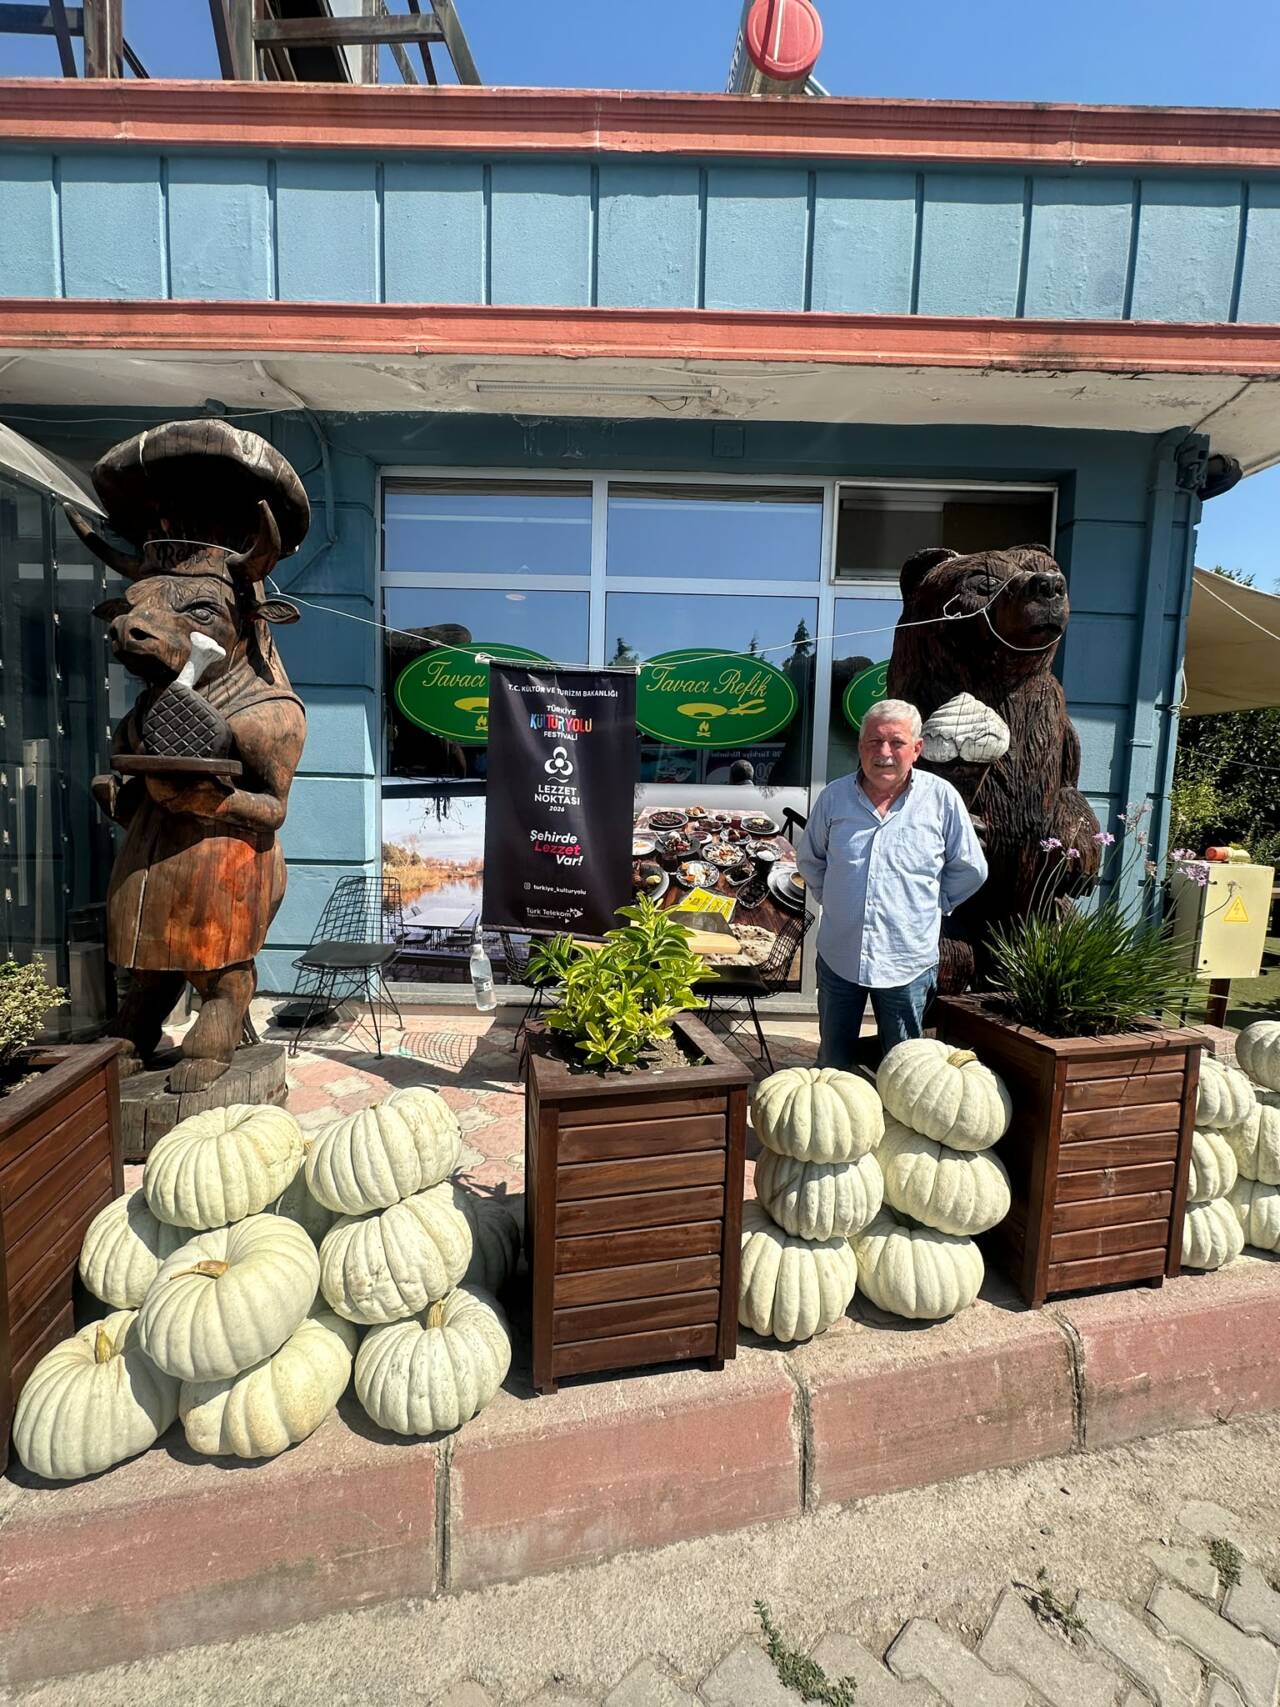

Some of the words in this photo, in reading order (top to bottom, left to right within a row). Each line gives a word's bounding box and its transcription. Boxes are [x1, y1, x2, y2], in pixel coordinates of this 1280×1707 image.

[422, 661, 487, 688] Tavacı
[508, 683, 521, 692] T.C.
[546, 686, 556, 694] VE
[556, 687, 582, 697] TURİZM
[582, 689, 618, 698] BAKANLIĞI
[646, 666, 711, 693] Tavacı
[713, 668, 773, 702] Refik
[546, 704, 577, 716] TÜRKİYE
[543, 731, 578, 741] FESTİVALİ
[538, 784, 577, 796] LEZZET
[534, 793, 581, 806] NOKTASI
[529, 829, 578, 844] Şehirde
[534, 841, 582, 856] Lezzet
[556, 854, 584, 866] Var!
[526, 907, 541, 915] Türk
[542, 909, 572, 918] Telekom
